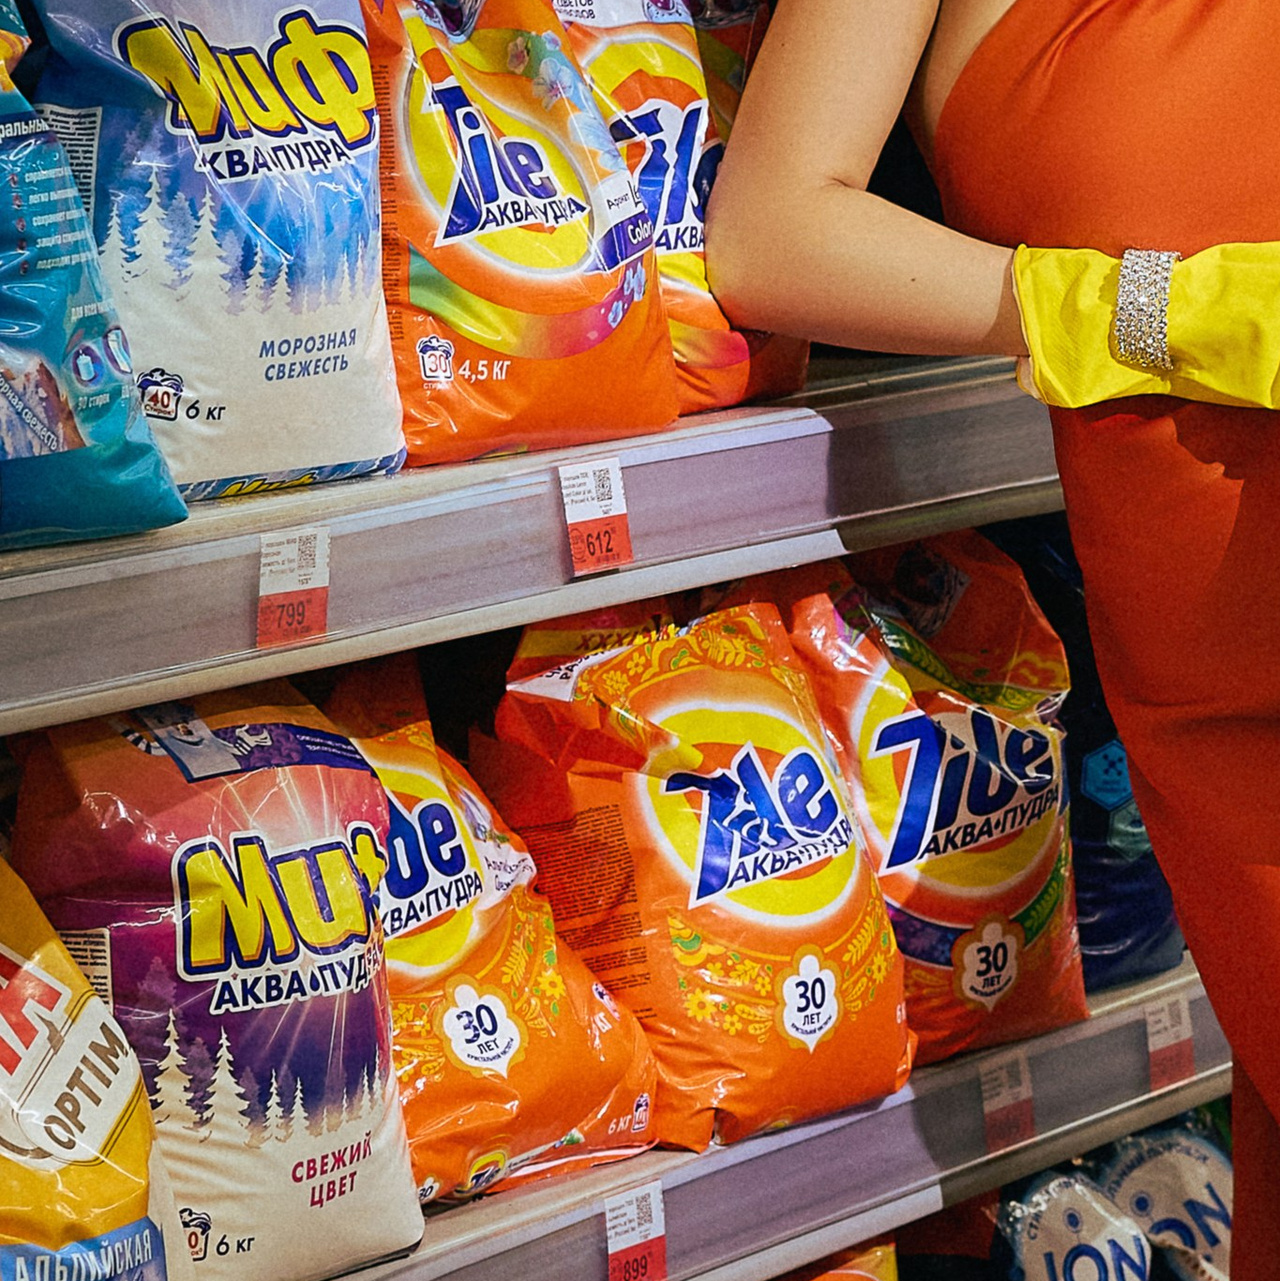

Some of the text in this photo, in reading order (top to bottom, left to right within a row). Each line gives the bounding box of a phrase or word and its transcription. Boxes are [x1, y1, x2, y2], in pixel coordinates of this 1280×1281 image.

[118, 9, 380, 144] Миф
[627, 220, 653, 245] Color
[259, 327, 357, 359] МОРОЗНАЯ
[264, 352, 350, 382] СВЕЖЕСТЬ
[427, 354, 448, 374] 30
[458, 356, 511, 382] 4,5 КГ
[148, 390, 171, 409] 40
[185, 399, 227, 421] 6 кг
[586, 530, 614, 557] 612
[275, 600, 307, 629] 799
[975, 941, 1009, 977] 30
[794, 976, 827, 1012] 30
[456, 1003, 498, 1044] 30
[802, 1013, 822, 1027] ЛЕТ
[477, 1037, 500, 1055] ЛЕТ
[43, 1021, 129, 1150] OPTIM
[608, 1119, 617, 1134] 6
[291, 1131, 372, 1184] СВЕЖИЙ
[309, 1171, 358, 1208] ЦВЕТ
[215, 1235, 255, 1256] 6 кг
